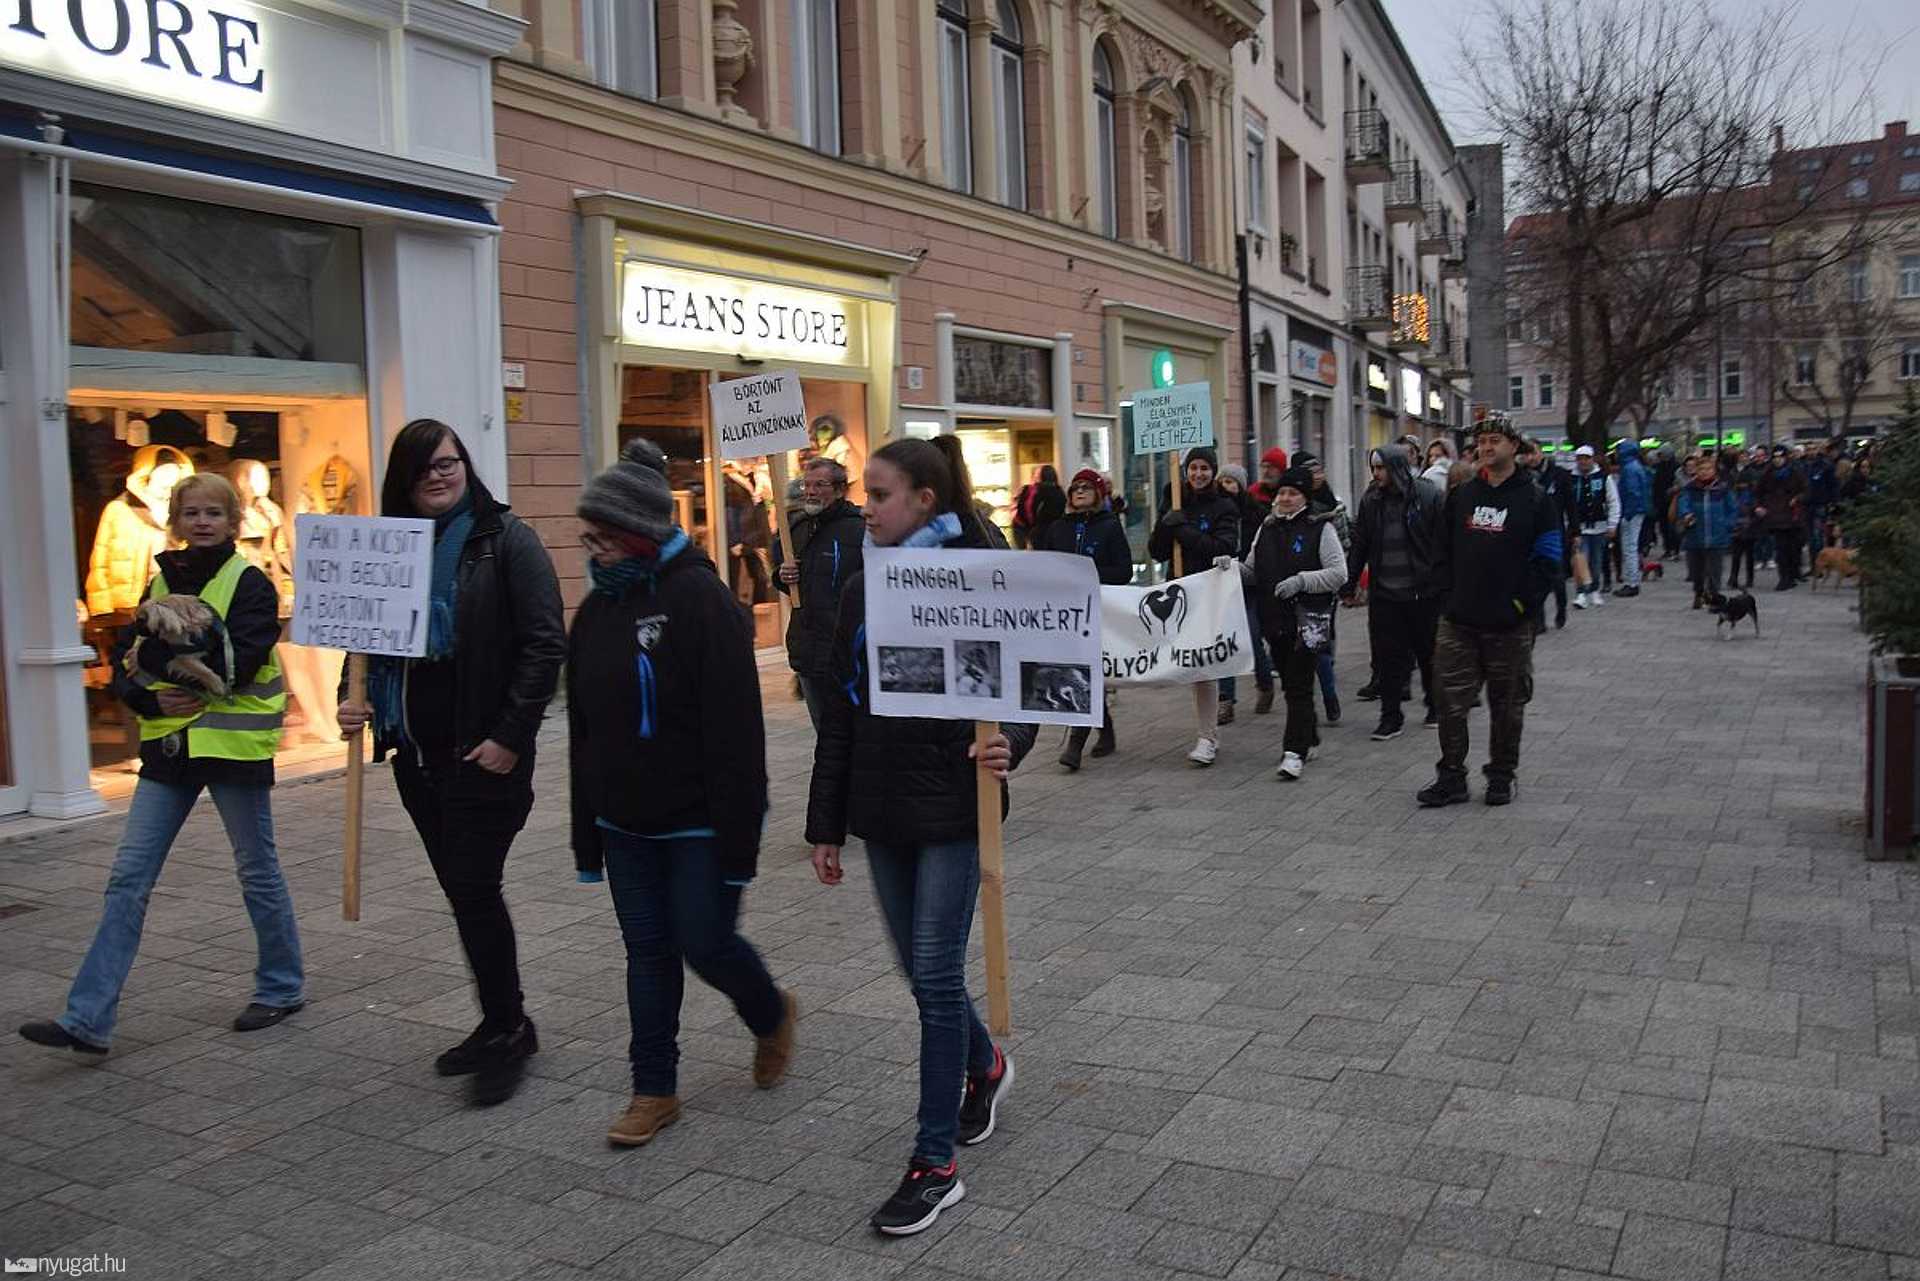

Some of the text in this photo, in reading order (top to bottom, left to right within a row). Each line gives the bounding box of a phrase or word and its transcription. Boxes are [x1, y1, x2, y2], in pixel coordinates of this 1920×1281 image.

[636, 285, 848, 347] JEANS STORE
[747, 400, 763, 415] AZ
[307, 524, 424, 554] AKI A KICSIT
[306, 559, 341, 583] NEM
[886, 564, 1007, 592] HANGGAL A
[302, 594, 313, 618] A
[911, 594, 1092, 637] HANGTALANOKÉRT!
[1170, 632, 1239, 668] MENTŐK
